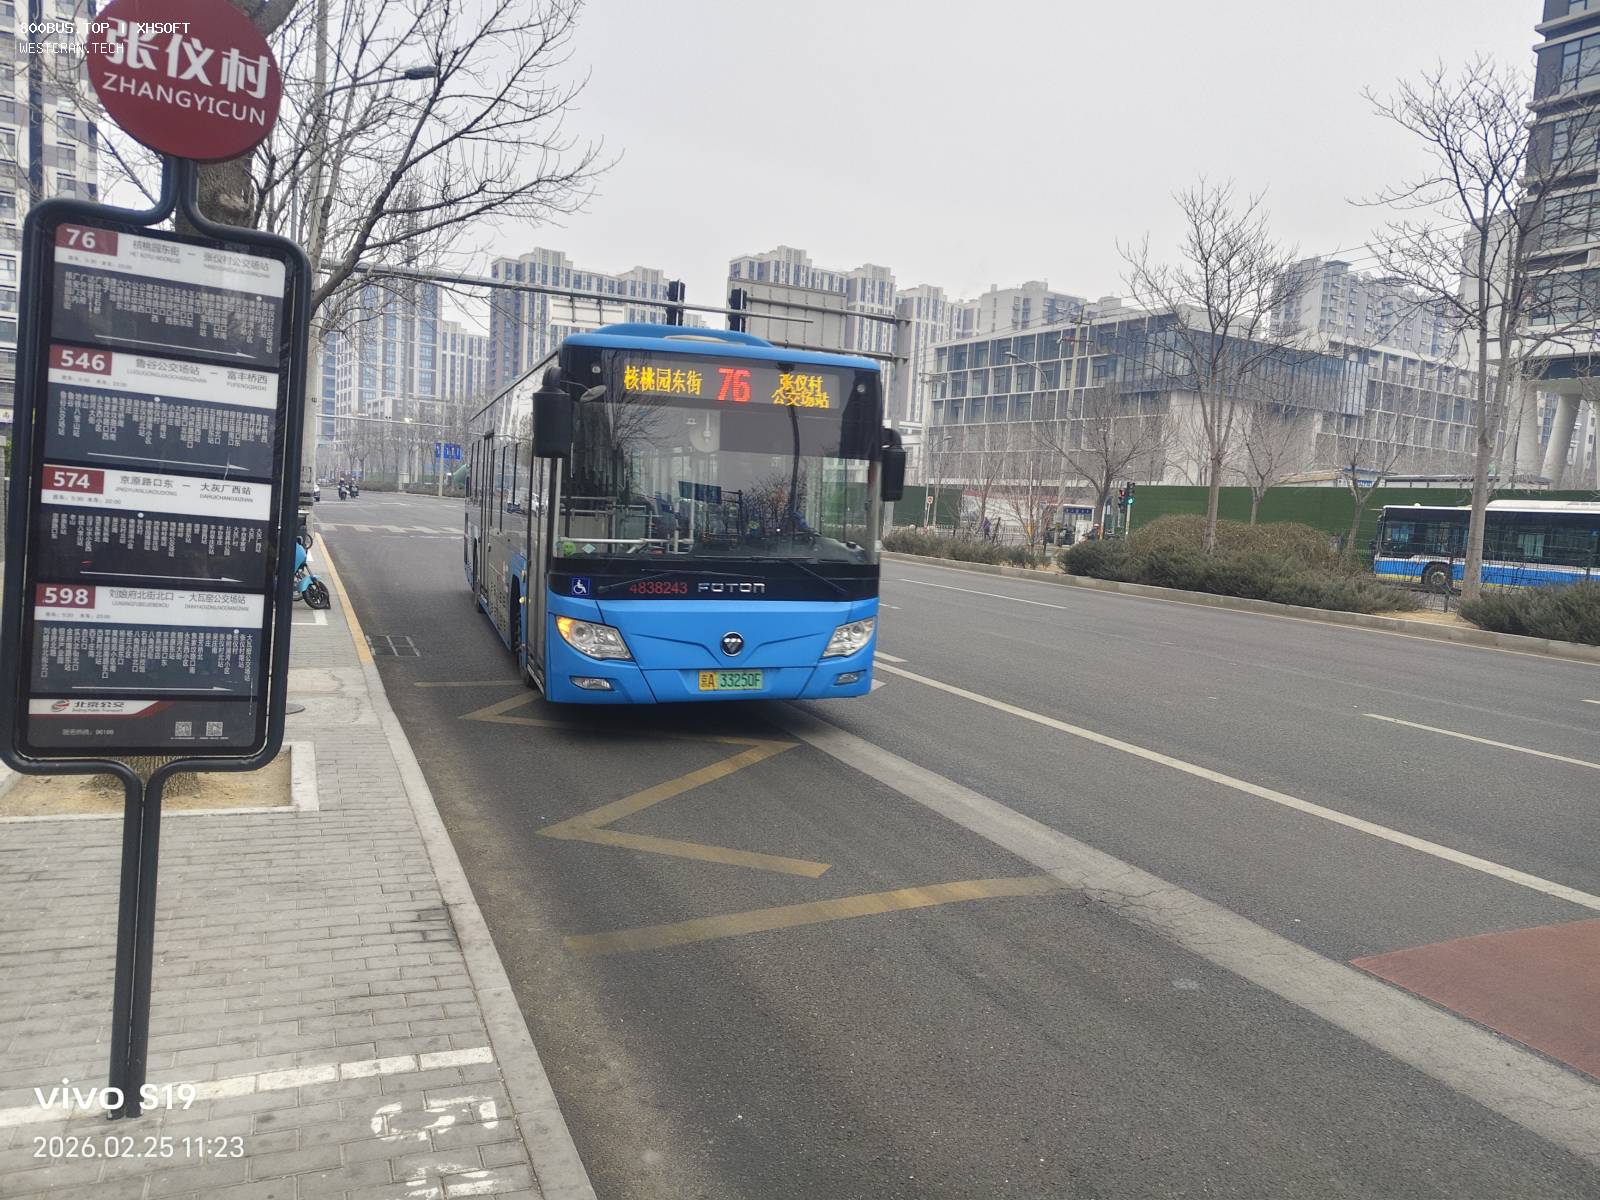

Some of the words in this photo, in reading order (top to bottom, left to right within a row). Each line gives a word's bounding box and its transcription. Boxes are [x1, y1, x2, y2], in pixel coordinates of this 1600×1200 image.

[105, 17, 271, 99] 张仪村
[102, 72, 266, 126] ZHANGYICUN
[66, 228, 96, 249] 76
[61, 350, 105, 370] 546
[135, 358, 200, 376] 鲁谷公交场站
[227, 371, 268, 385] 富丰桥西
[623, 365, 703, 396] 核桃园东街
[717, 367, 752, 403] 76
[778, 374, 823, 392] 张仪村
[771, 389, 830, 409] 公交场站
[53, 471, 91, 489] 574
[119, 475, 173, 489] 京原路口东
[200, 482, 252, 495] 大灰厂西站
[44, 587, 89, 605] 598
[188, 593, 246, 605] 大瓦窑公交场站
[629, 582, 688, 595] 4838243
[698, 582, 766, 593] FOTON
[720, 673, 761, 688] 33250F
